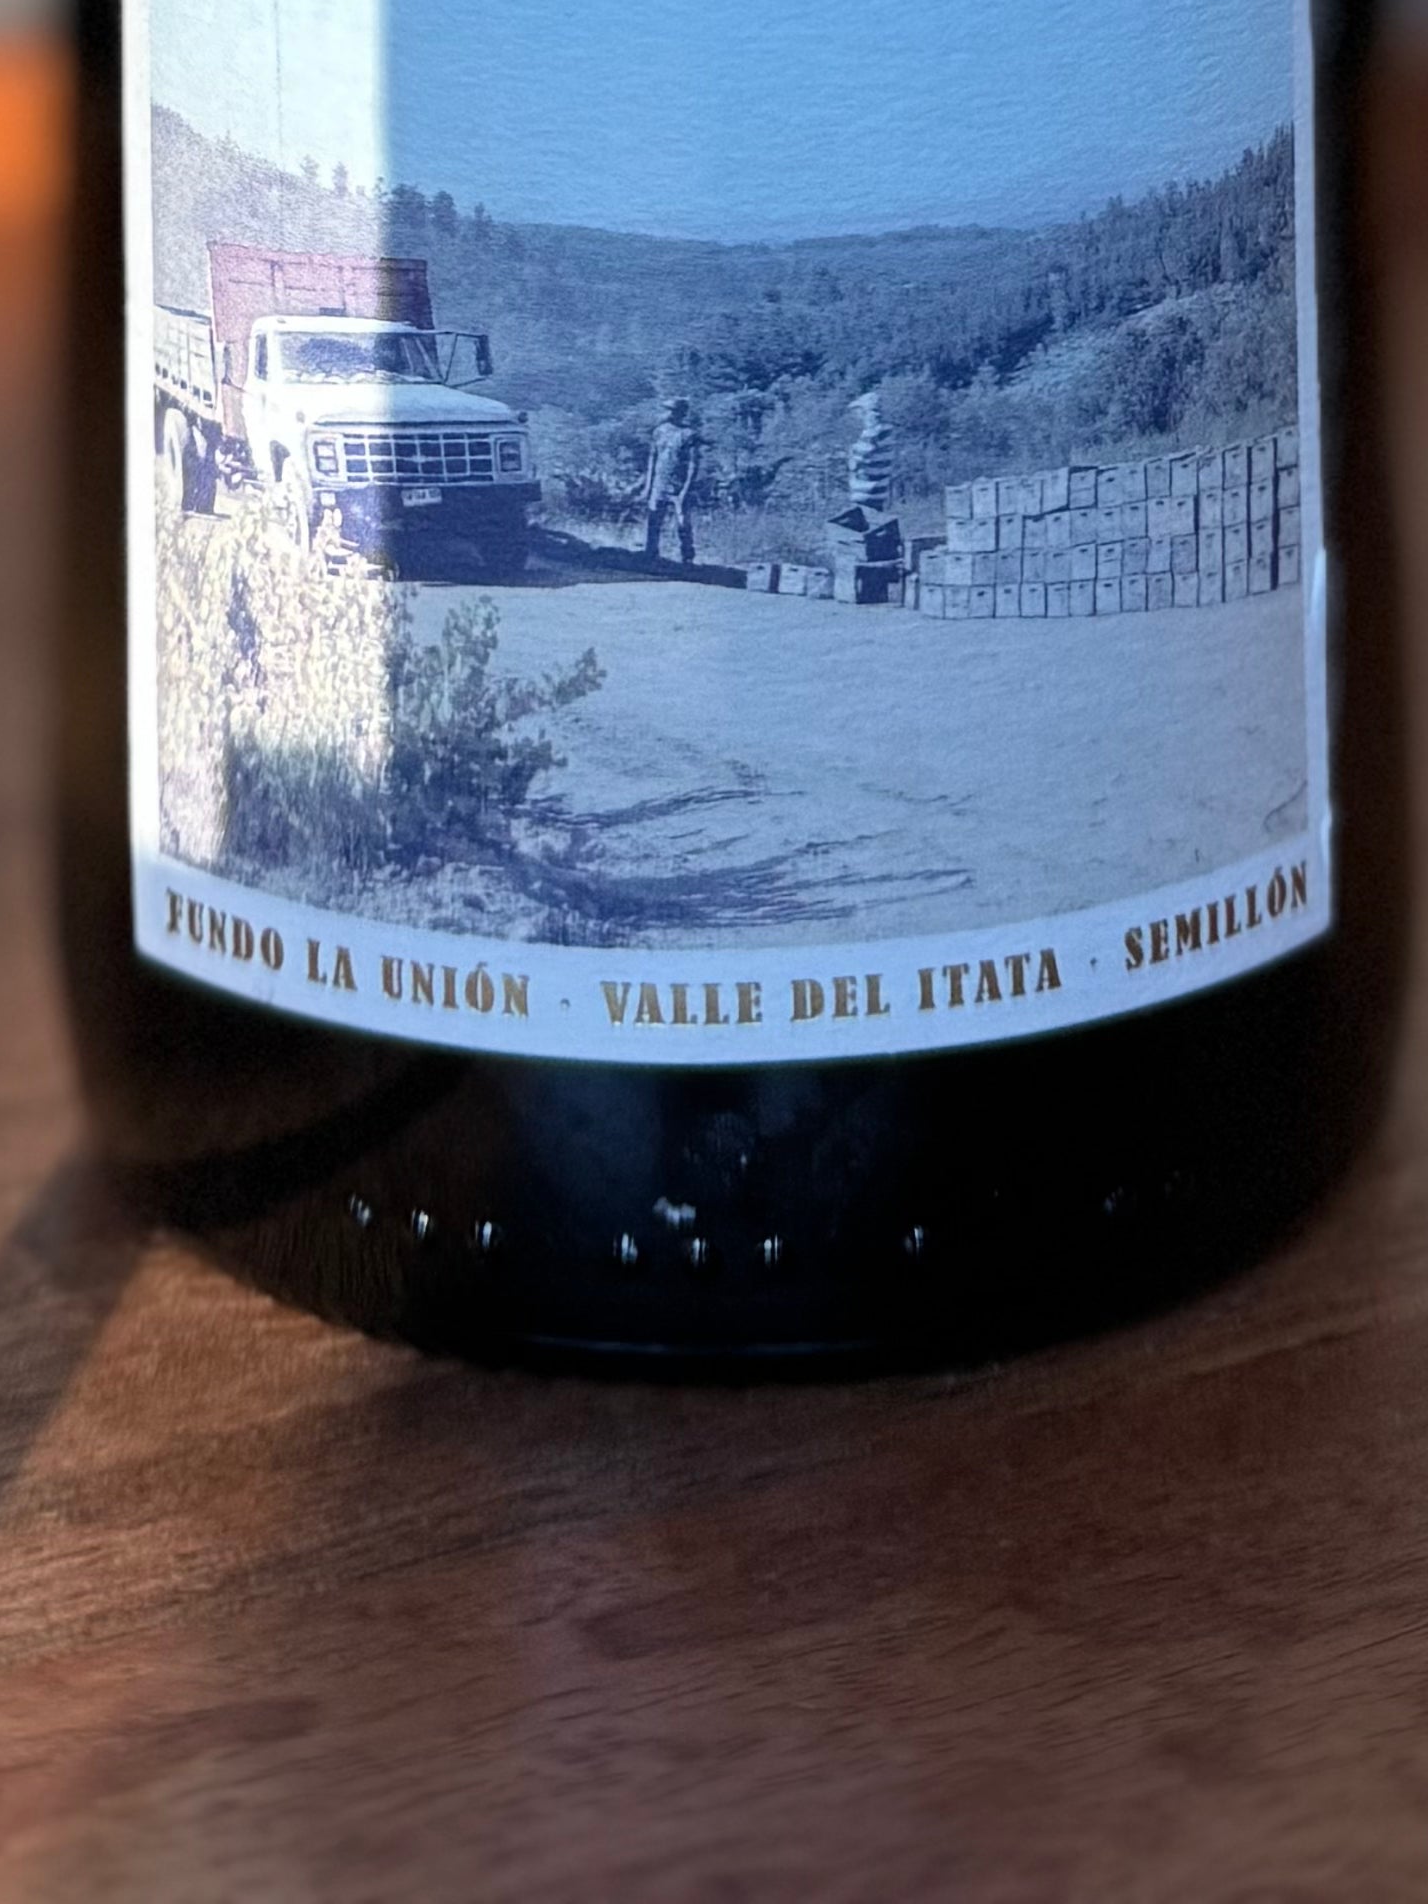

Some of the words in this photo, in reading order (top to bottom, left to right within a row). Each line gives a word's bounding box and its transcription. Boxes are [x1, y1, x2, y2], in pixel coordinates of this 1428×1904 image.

[165, 890, 284, 970] FUNDO
[307, 939, 357, 991] LA
[380, 957, 530, 1016] UNIÓN
[600, 982, 763, 1025] VALLE
[789, 975, 890, 1021] DEL
[918, 948, 1061, 1010] ITATA
[1124, 861, 1307, 970] SEMILLÓN
